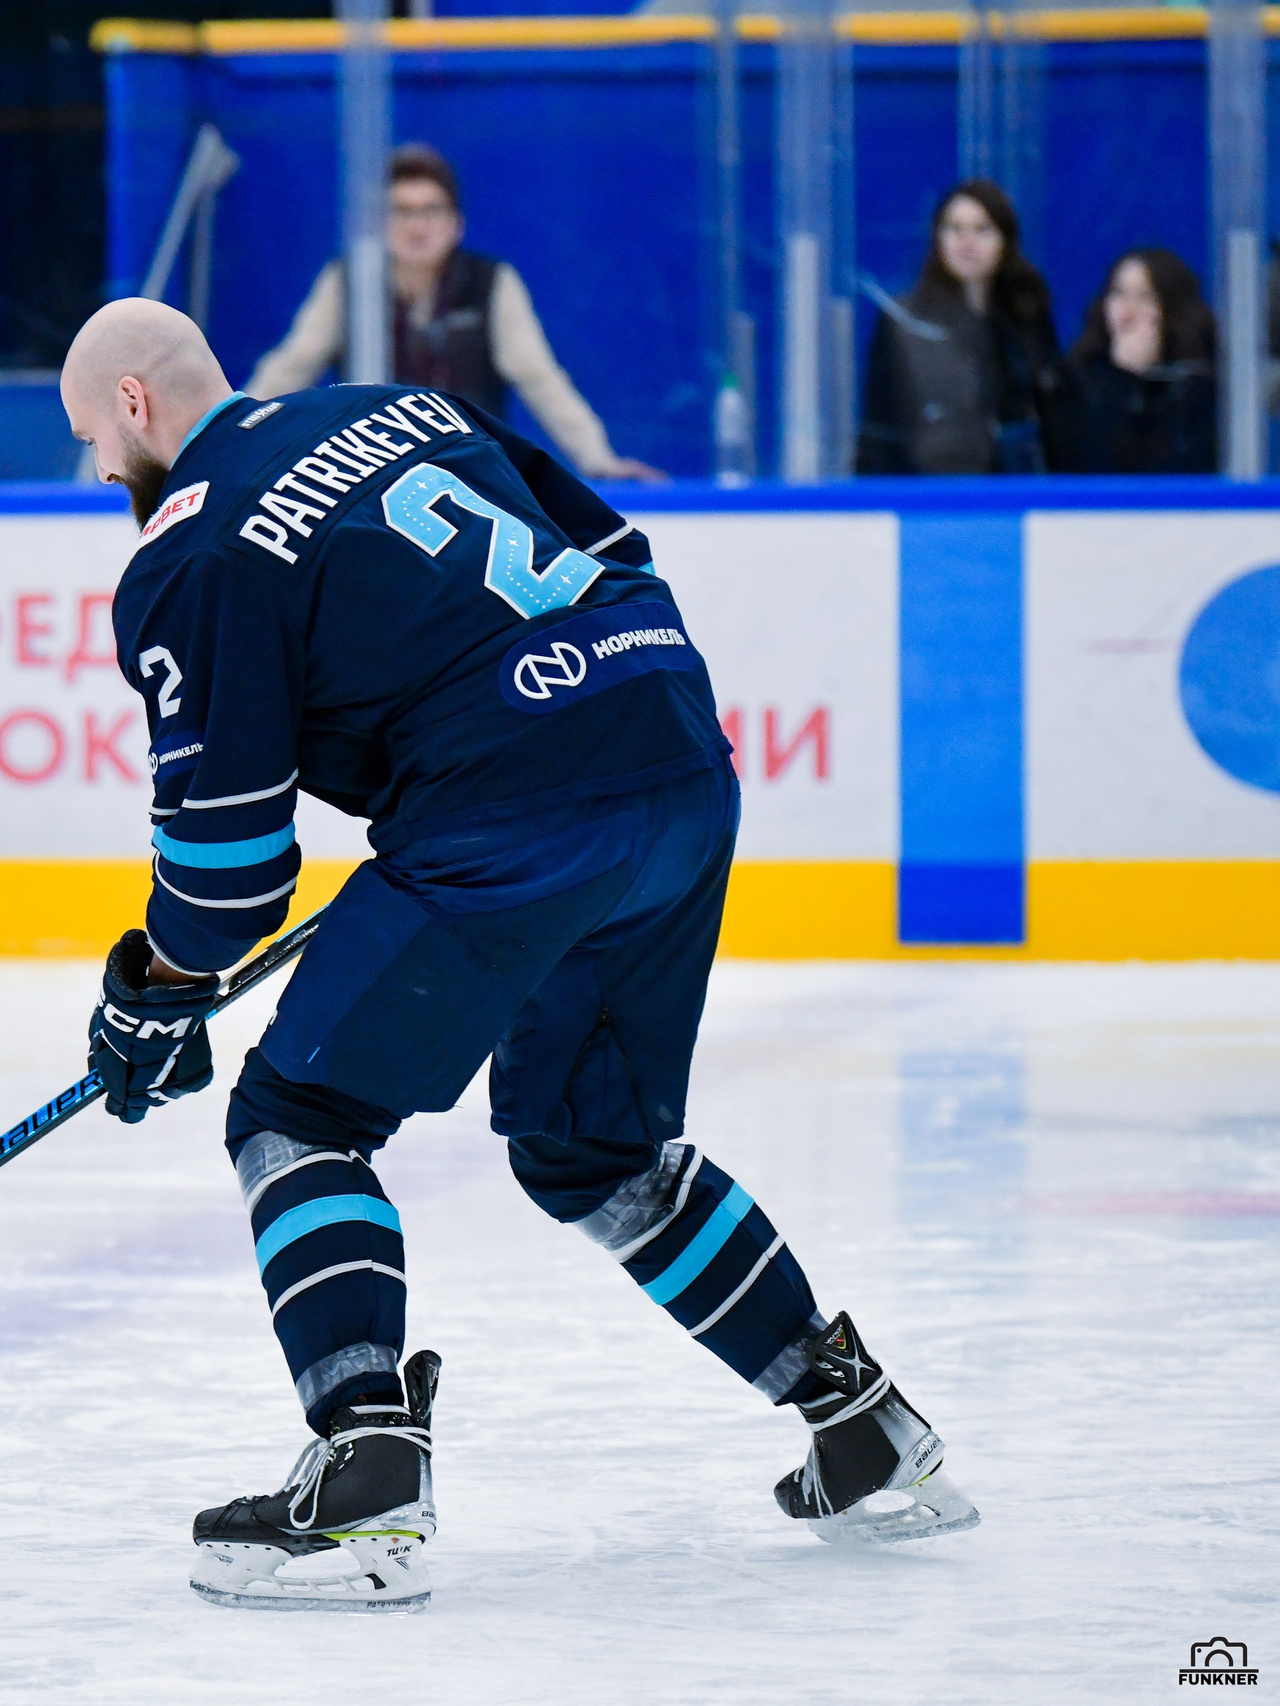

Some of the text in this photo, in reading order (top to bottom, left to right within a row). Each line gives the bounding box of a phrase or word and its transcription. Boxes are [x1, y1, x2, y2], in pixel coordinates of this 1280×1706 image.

[239, 392, 473, 565] PATRIKEYEV
[381, 462, 607, 620] 2
[591, 629, 686, 660] НОРНИКЕЛЬ
[138, 645, 183, 718] 2
[159, 742, 204, 765] НОРНИКЕЛЬ
[915, 1437, 942, 1469] BAUER
